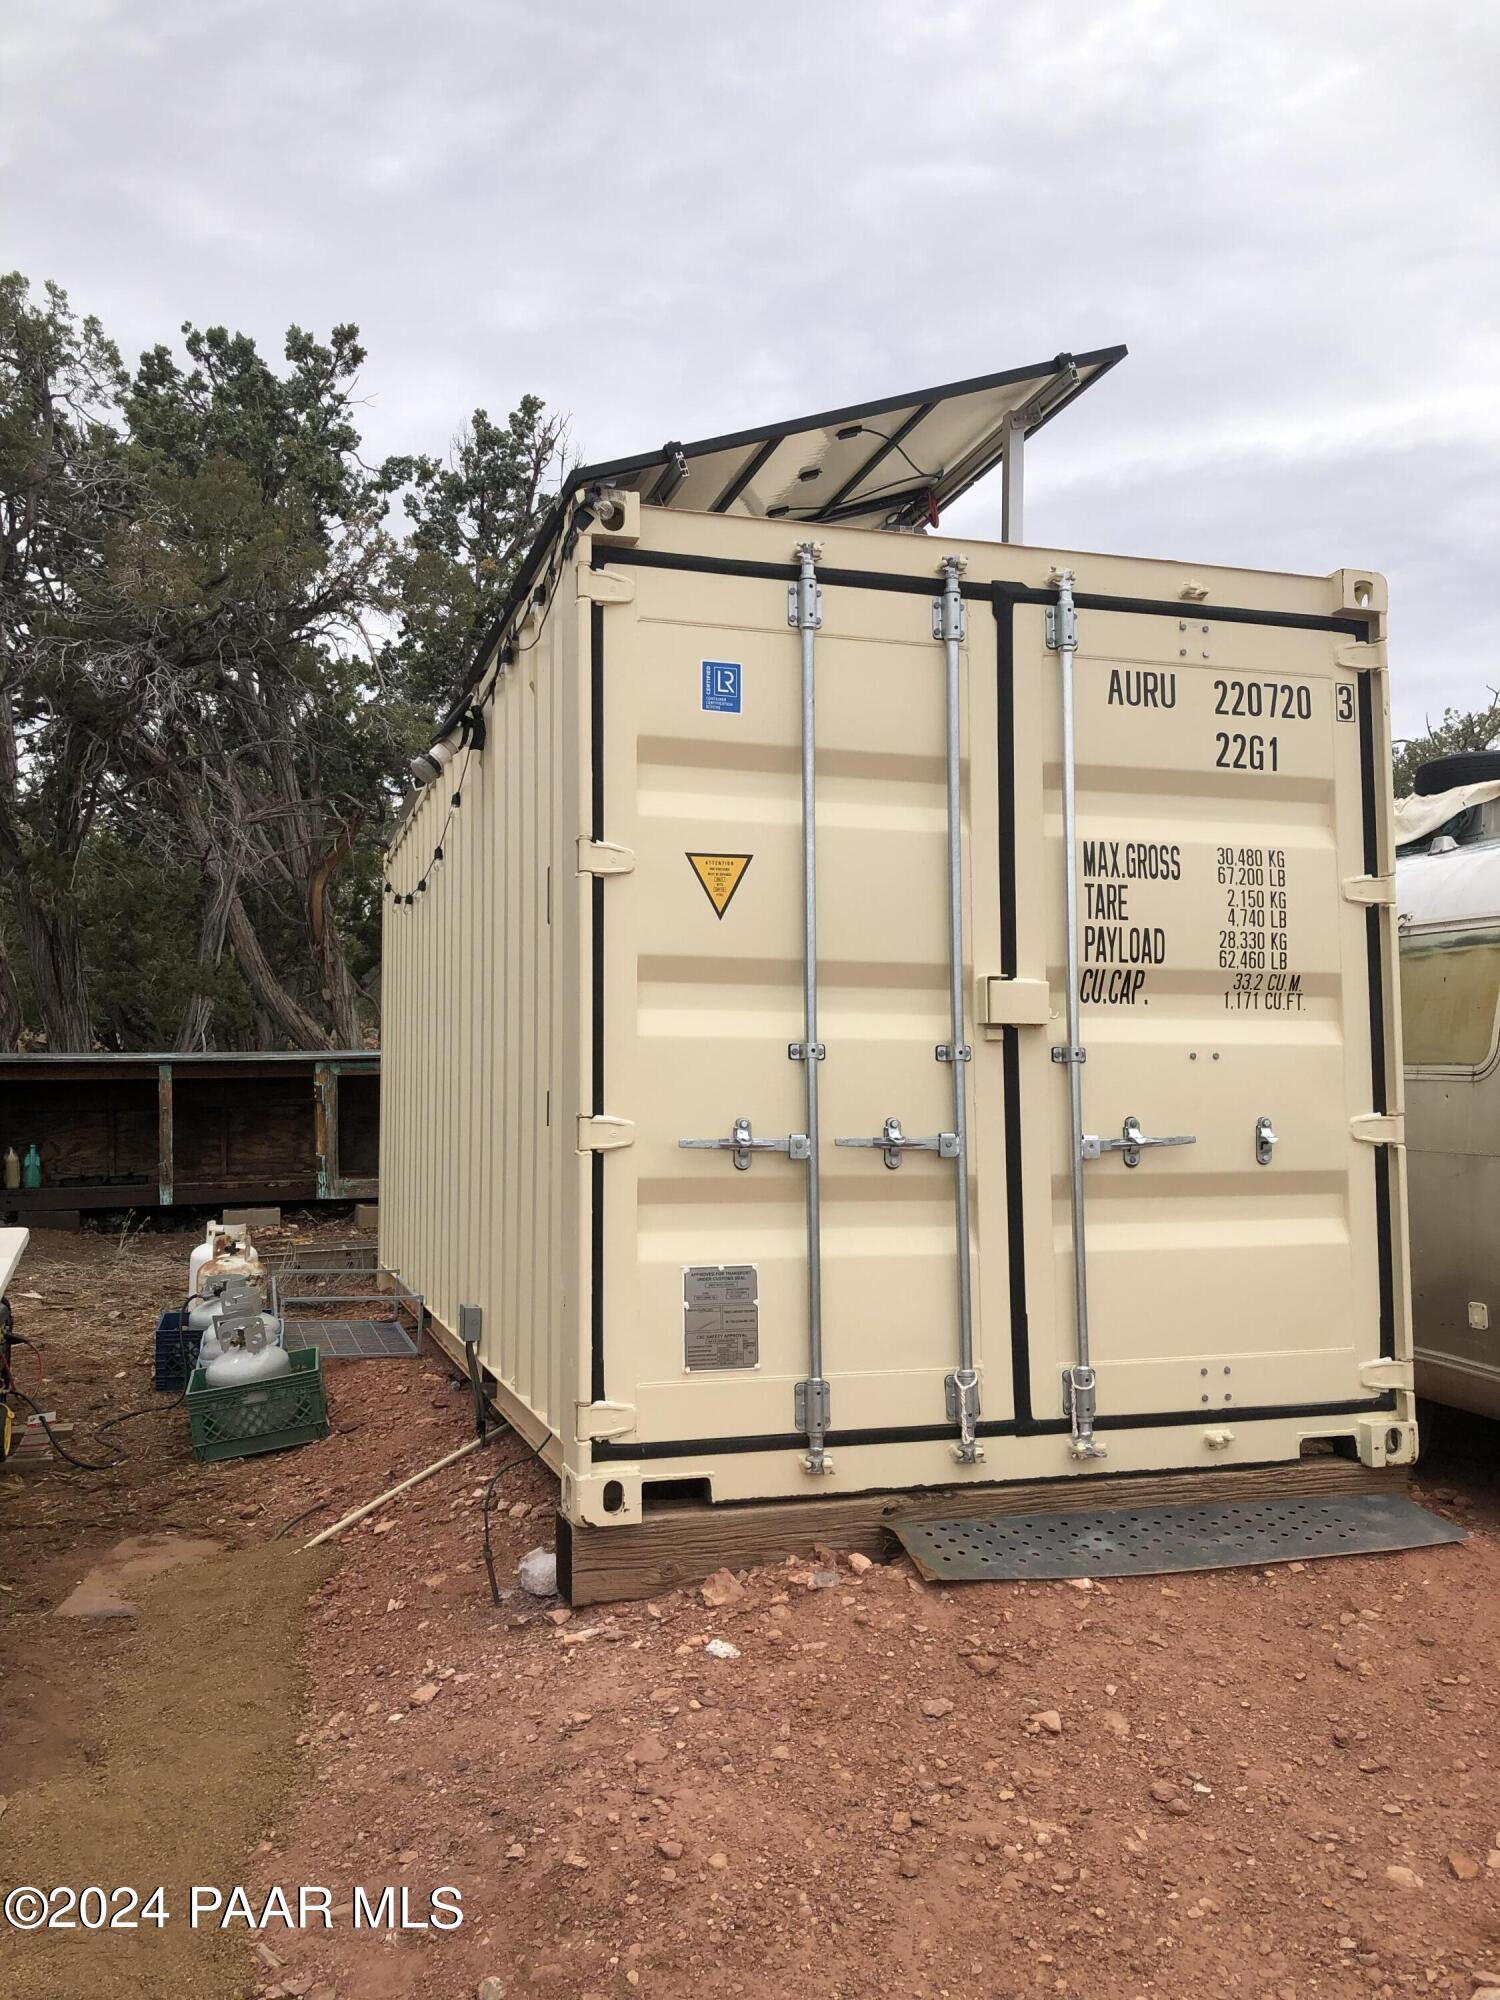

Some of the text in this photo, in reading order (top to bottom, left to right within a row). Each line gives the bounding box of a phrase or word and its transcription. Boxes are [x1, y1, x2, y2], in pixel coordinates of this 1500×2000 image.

[1107, 669, 1354, 720] AURU 220720 3
[1215, 731, 1279, 772] 22G1
[1082, 840, 1182, 881] MAX.GROSS
[1216, 847, 1286, 869] 30,480 KG
[1217, 866, 1287, 888] 67,200 LB
[1084, 883, 1130, 921] TARE
[1270, 890, 1288, 910] KG
[1270, 910, 1288, 929] LB
[1084, 925, 1166, 965] PAYLOAD
[1218, 930, 1288, 951] 28,330 KG
[1218, 950, 1288, 971] 62,460 LB
[1079, 968, 1149, 1006] CU.CAP.
[1232, 973, 1264, 992] 33.2
